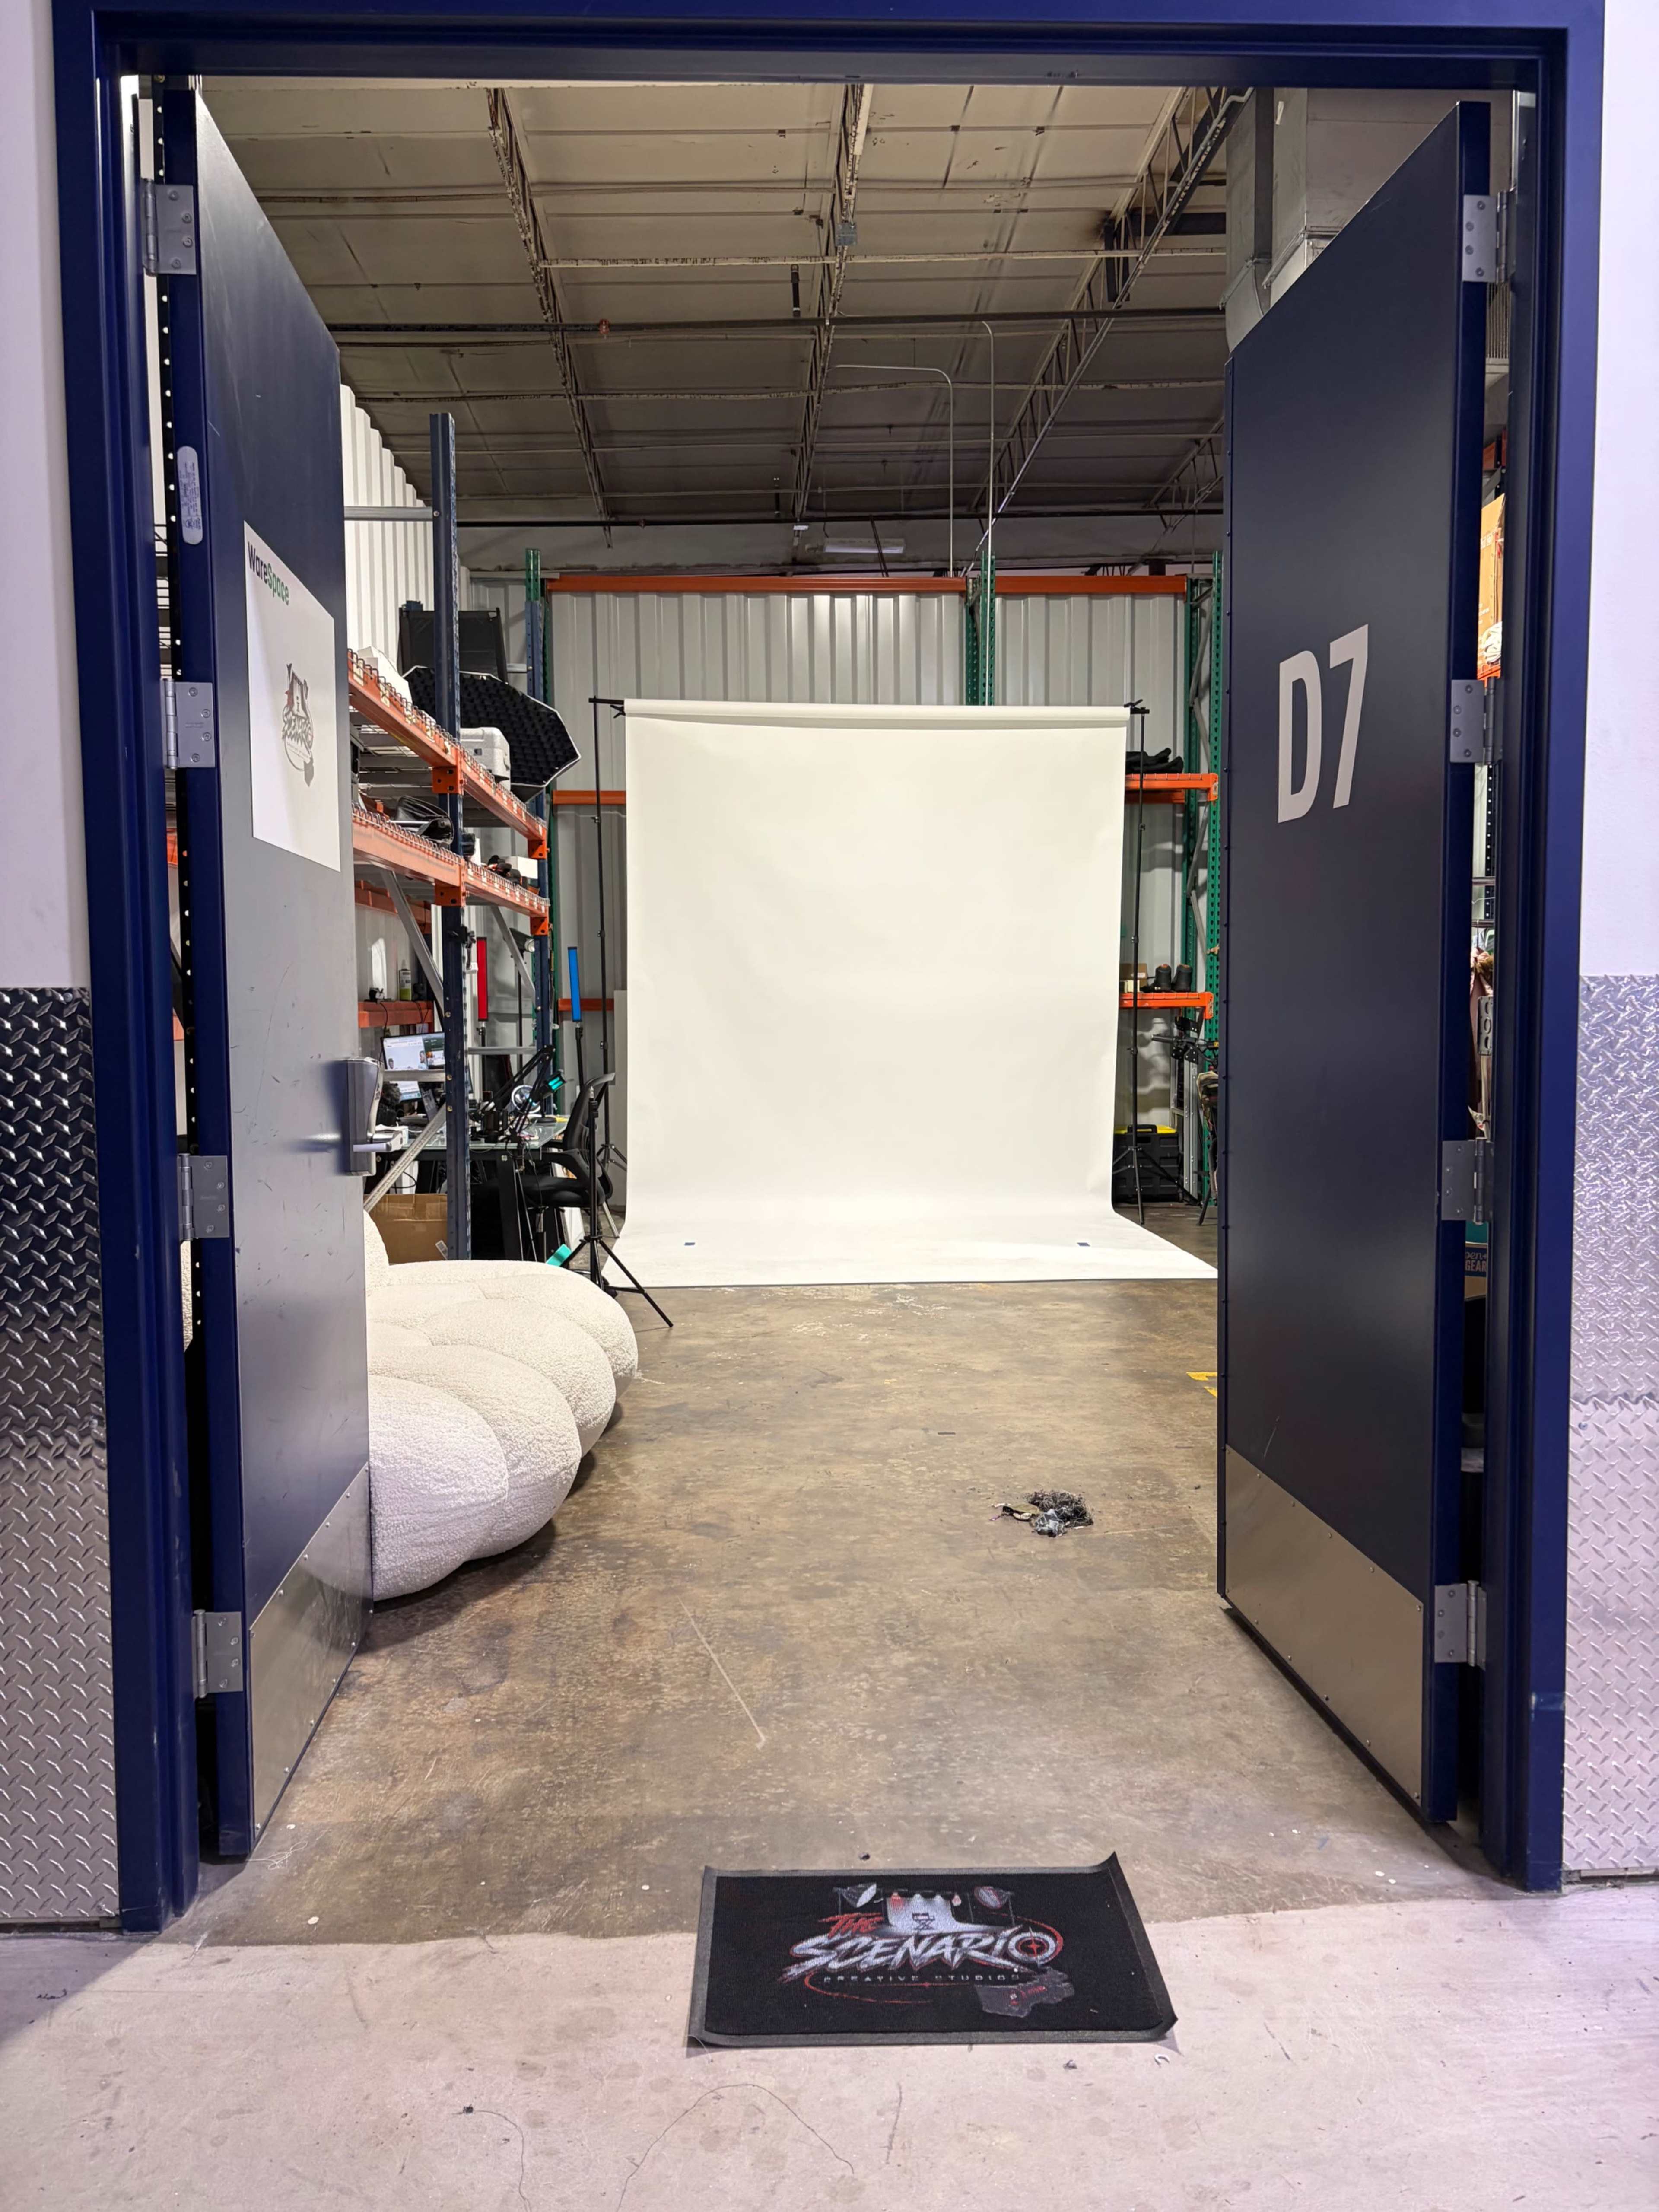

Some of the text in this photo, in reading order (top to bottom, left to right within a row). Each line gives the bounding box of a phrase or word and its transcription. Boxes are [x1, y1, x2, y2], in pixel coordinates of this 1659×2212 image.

[248, 541, 289, 606] WareSpace
[1278, 624, 1368, 823] D7
[1465, 1260, 1487, 1272] GEAR
[779, 1924, 1058, 1982] SCENARIO
